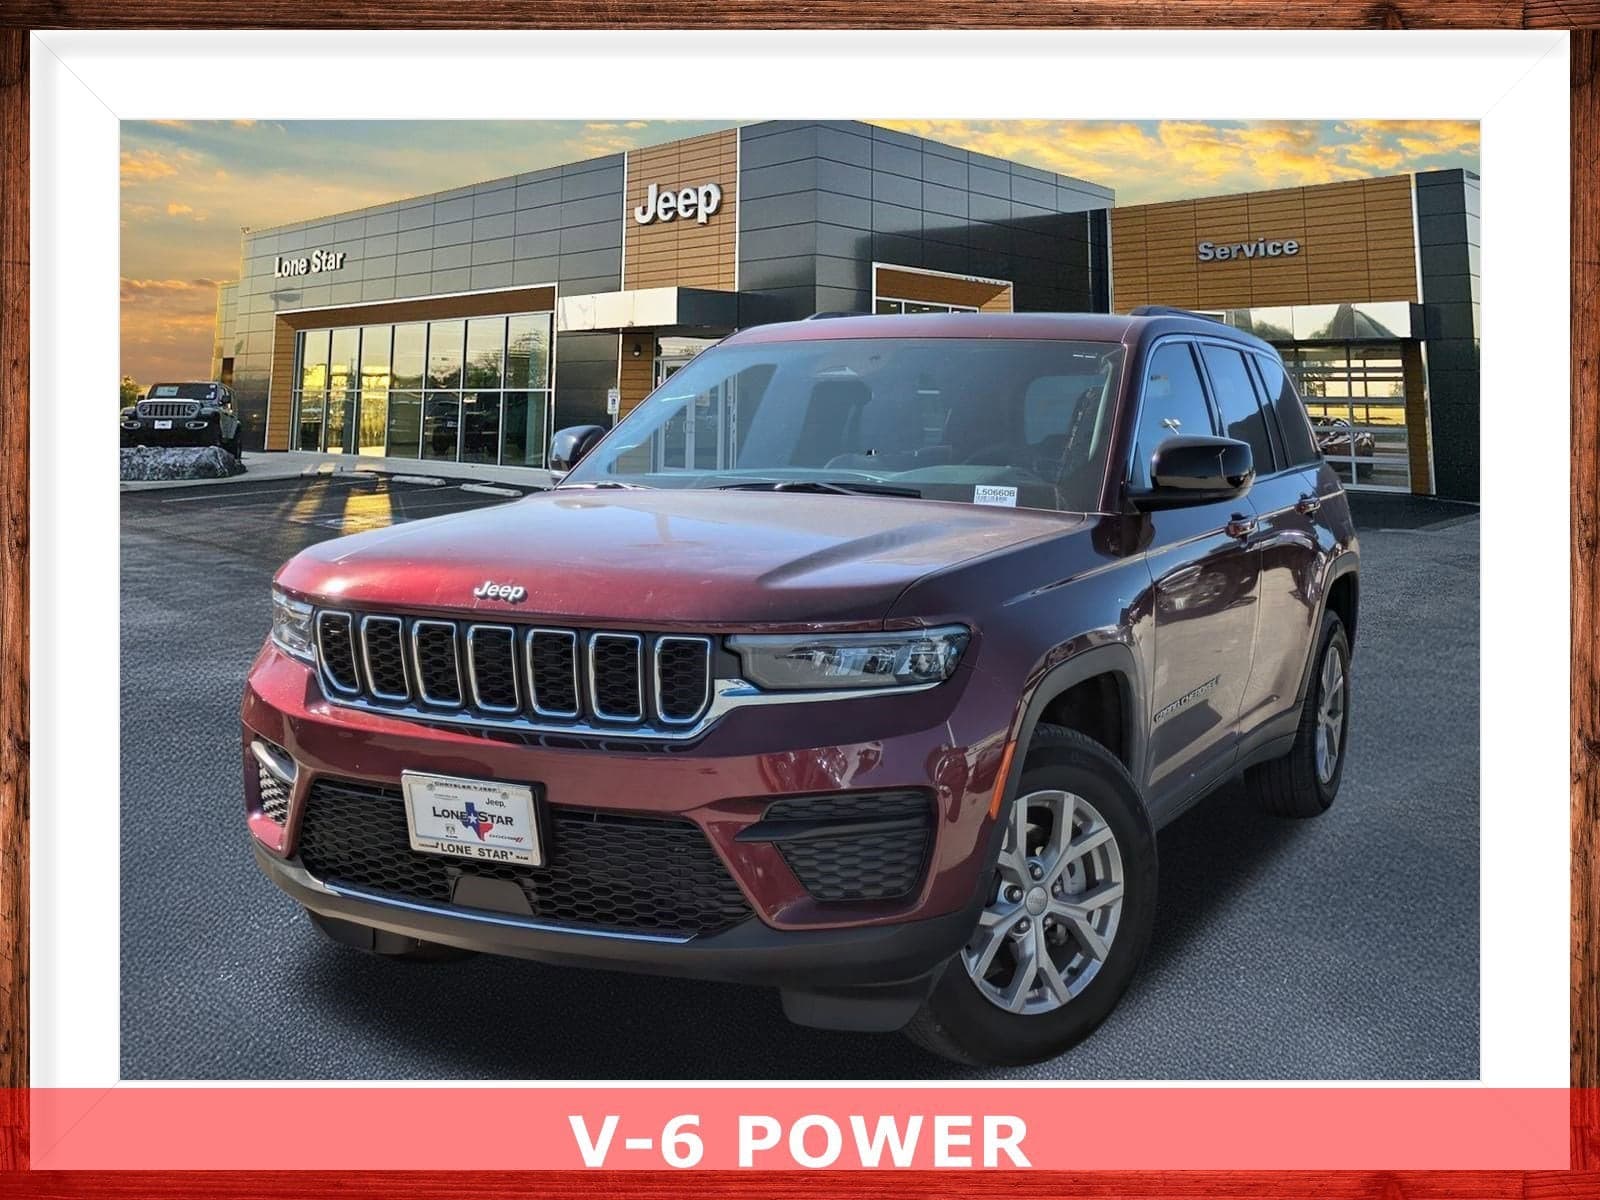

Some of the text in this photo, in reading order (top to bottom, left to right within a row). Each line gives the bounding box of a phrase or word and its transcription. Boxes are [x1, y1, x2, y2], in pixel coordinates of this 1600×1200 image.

[634, 182, 722, 225] Jeep
[1198, 237, 1300, 261] Service
[274, 249, 346, 278] Lone Star
[473, 580, 527, 603] Jeep
[485, 798, 504, 808] Jeep
[432, 806, 514, 827] LONE STAR
[440, 842, 472, 855] LONE
[478, 847, 509, 860] STAR
